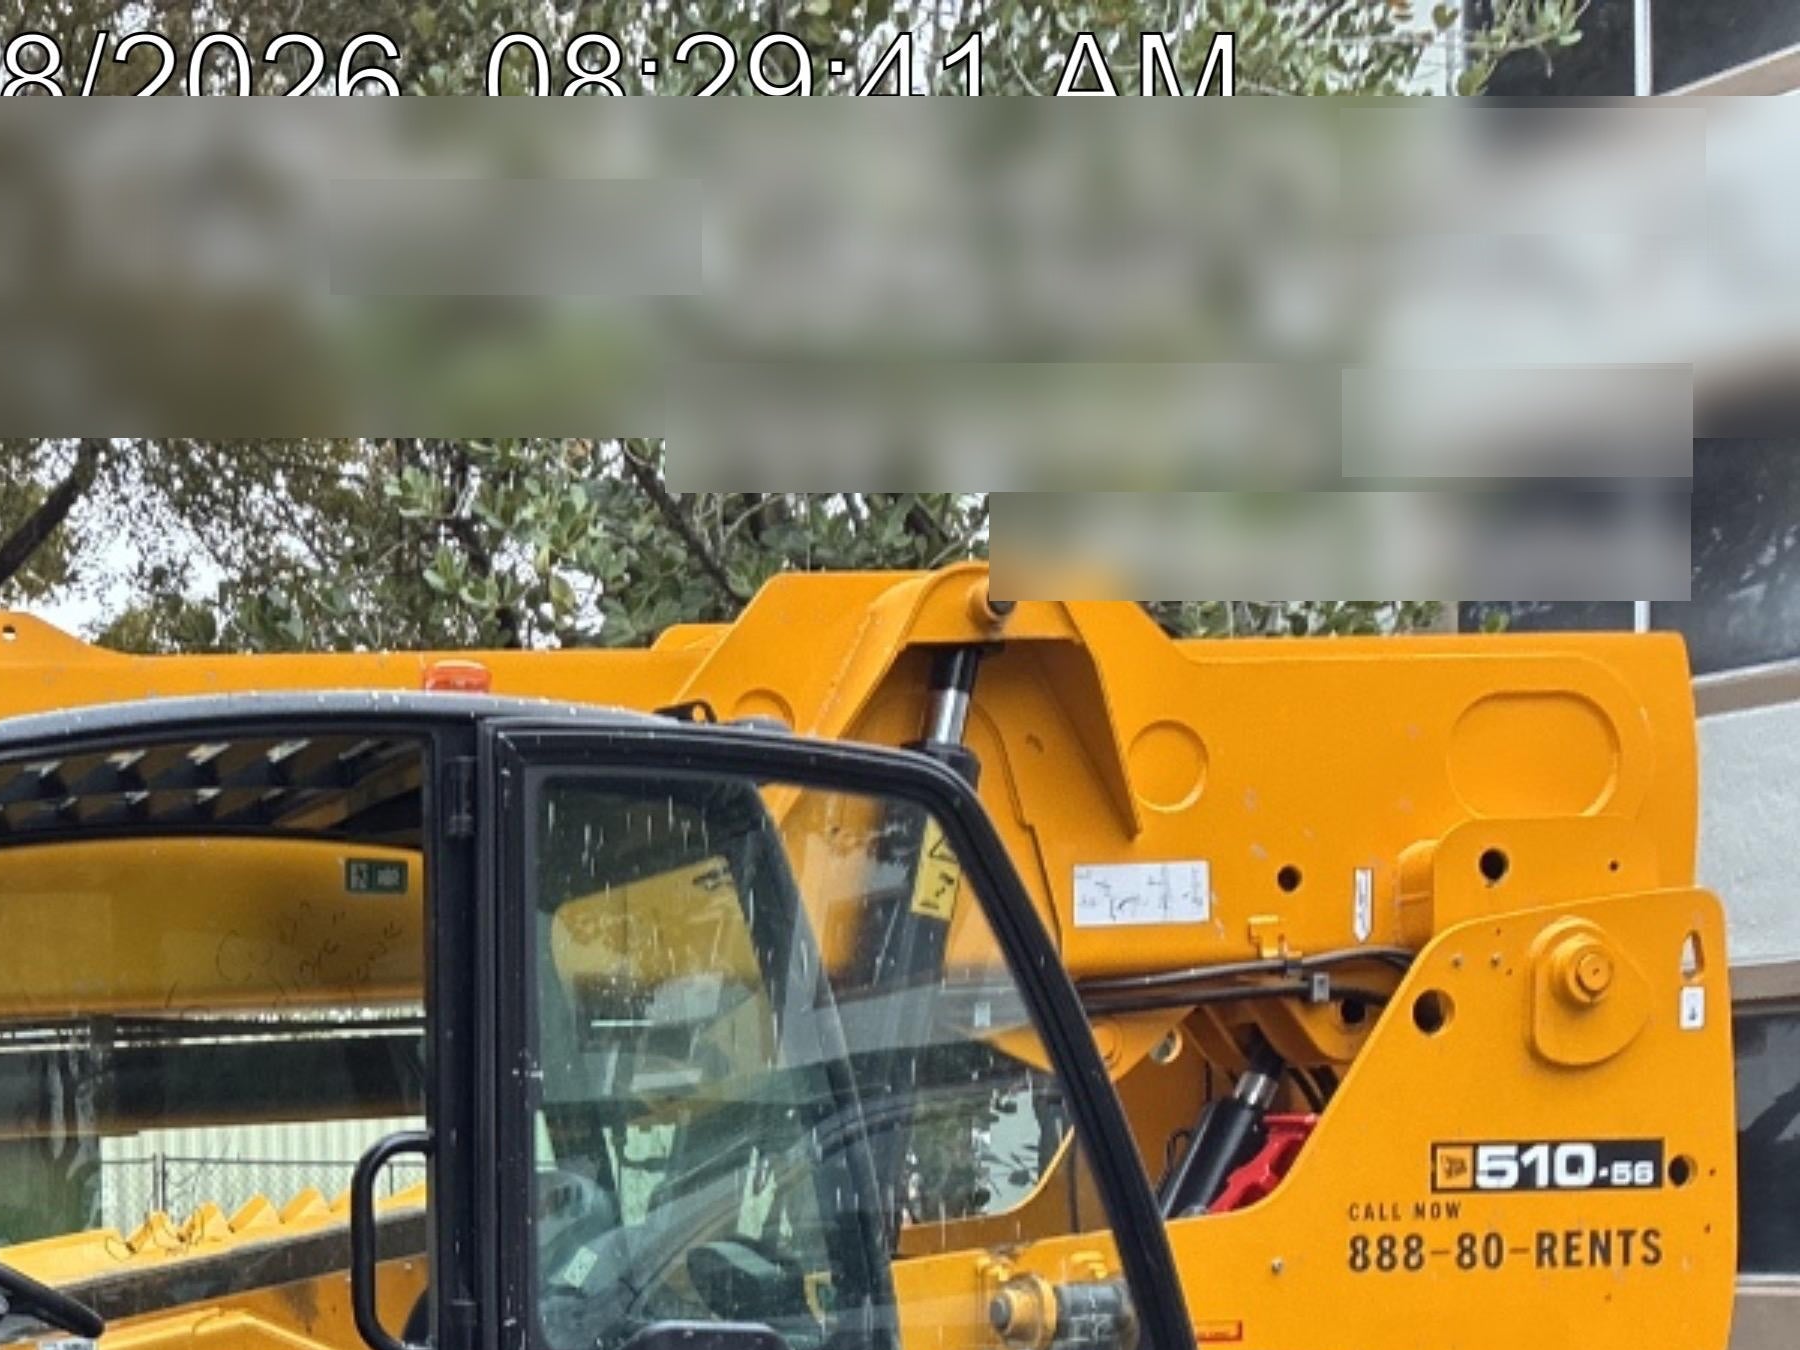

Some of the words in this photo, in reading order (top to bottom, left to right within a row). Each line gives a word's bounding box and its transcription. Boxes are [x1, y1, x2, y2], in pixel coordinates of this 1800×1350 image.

[1348, 1202, 1403, 1222] CALL
[1414, 1200, 1462, 1222] NOW
[1348, 1227, 1663, 1273] 888-80-RENTS
